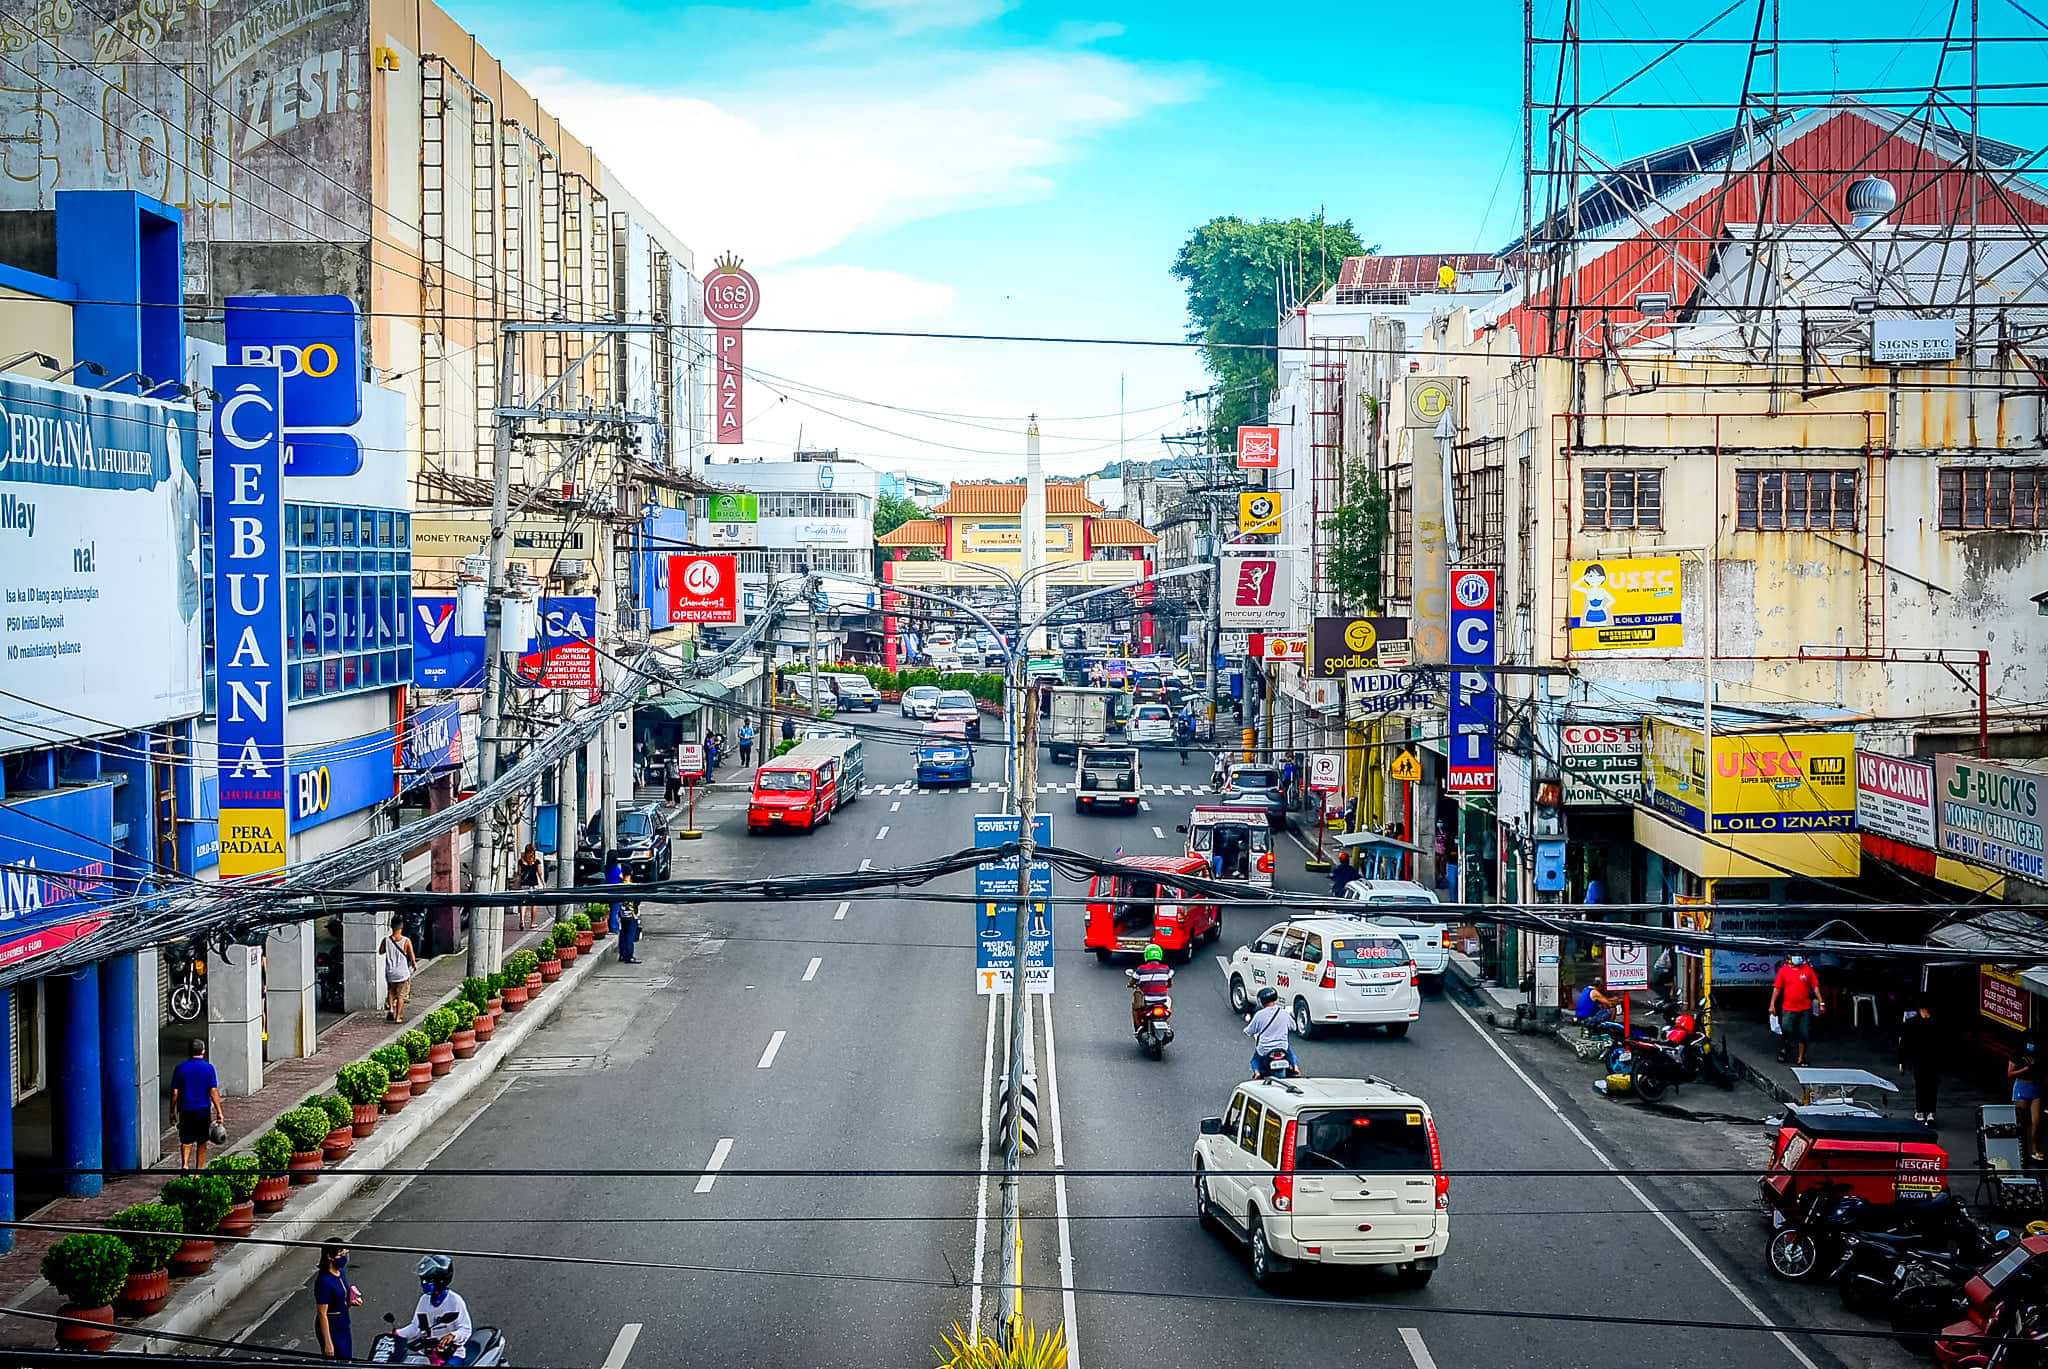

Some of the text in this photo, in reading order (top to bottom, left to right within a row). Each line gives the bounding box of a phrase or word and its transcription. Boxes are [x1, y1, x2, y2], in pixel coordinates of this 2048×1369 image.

[240, 45, 362, 157] ZEST!
[713, 286, 747, 303] 168
[1878, 339, 1953, 349] SIGNS ETC.
[241, 343, 338, 378] BDO
[722, 336, 737, 427] PLAZA
[98, 447, 152, 476] LHUILLIER
[1, 494, 36, 537] May
[415, 534, 490, 545] MONEY TRANSF
[514, 531, 572, 540] WESTERN
[532, 539, 572, 548] UNION
[73, 540, 96, 573] na!
[220, 384, 275, 779] CEBUANA
[1609, 570, 1674, 589] USSC
[41, 614, 64, 631] Deposit
[673, 610, 700, 620] OPEN
[1265, 610, 1286, 618] drug
[7, 645, 18, 660] NO
[58, 640, 81, 655] balance
[1324, 654, 1379, 675] goldiloc
[1360, 694, 1435, 713] SHOPPE
[1565, 727, 1643, 744] COST
[686, 746, 695, 754] NO
[1566, 743, 1622, 754] MEDICINE
[1565, 756, 1638, 770] One plus
[1718, 751, 1803, 777] USSC
[1451, 772, 1495, 785] MART
[1572, 773, 1643, 786] PAWNSH
[1860, 757, 1927, 800] NS OCANA
[298, 765, 331, 819] BDO
[1565, 789, 1610, 801] MONEY
[1948, 765, 2037, 817] J-BUCK'S
[977, 824, 1018, 832] COVID-19
[1713, 815, 1854, 830] ILOILO IZNART
[1944, 801, 1985, 835] MONEY
[1985, 813, 2044, 852] CHANGER
[231, 826, 273, 839] PERA
[220, 840, 284, 854] PADALA
[1944, 831, 2044, 876] WE BUY GIFT CHEQUE
[1000, 970, 1050, 979] TAUAY
[1610, 968, 1644, 978] NO PARKING
